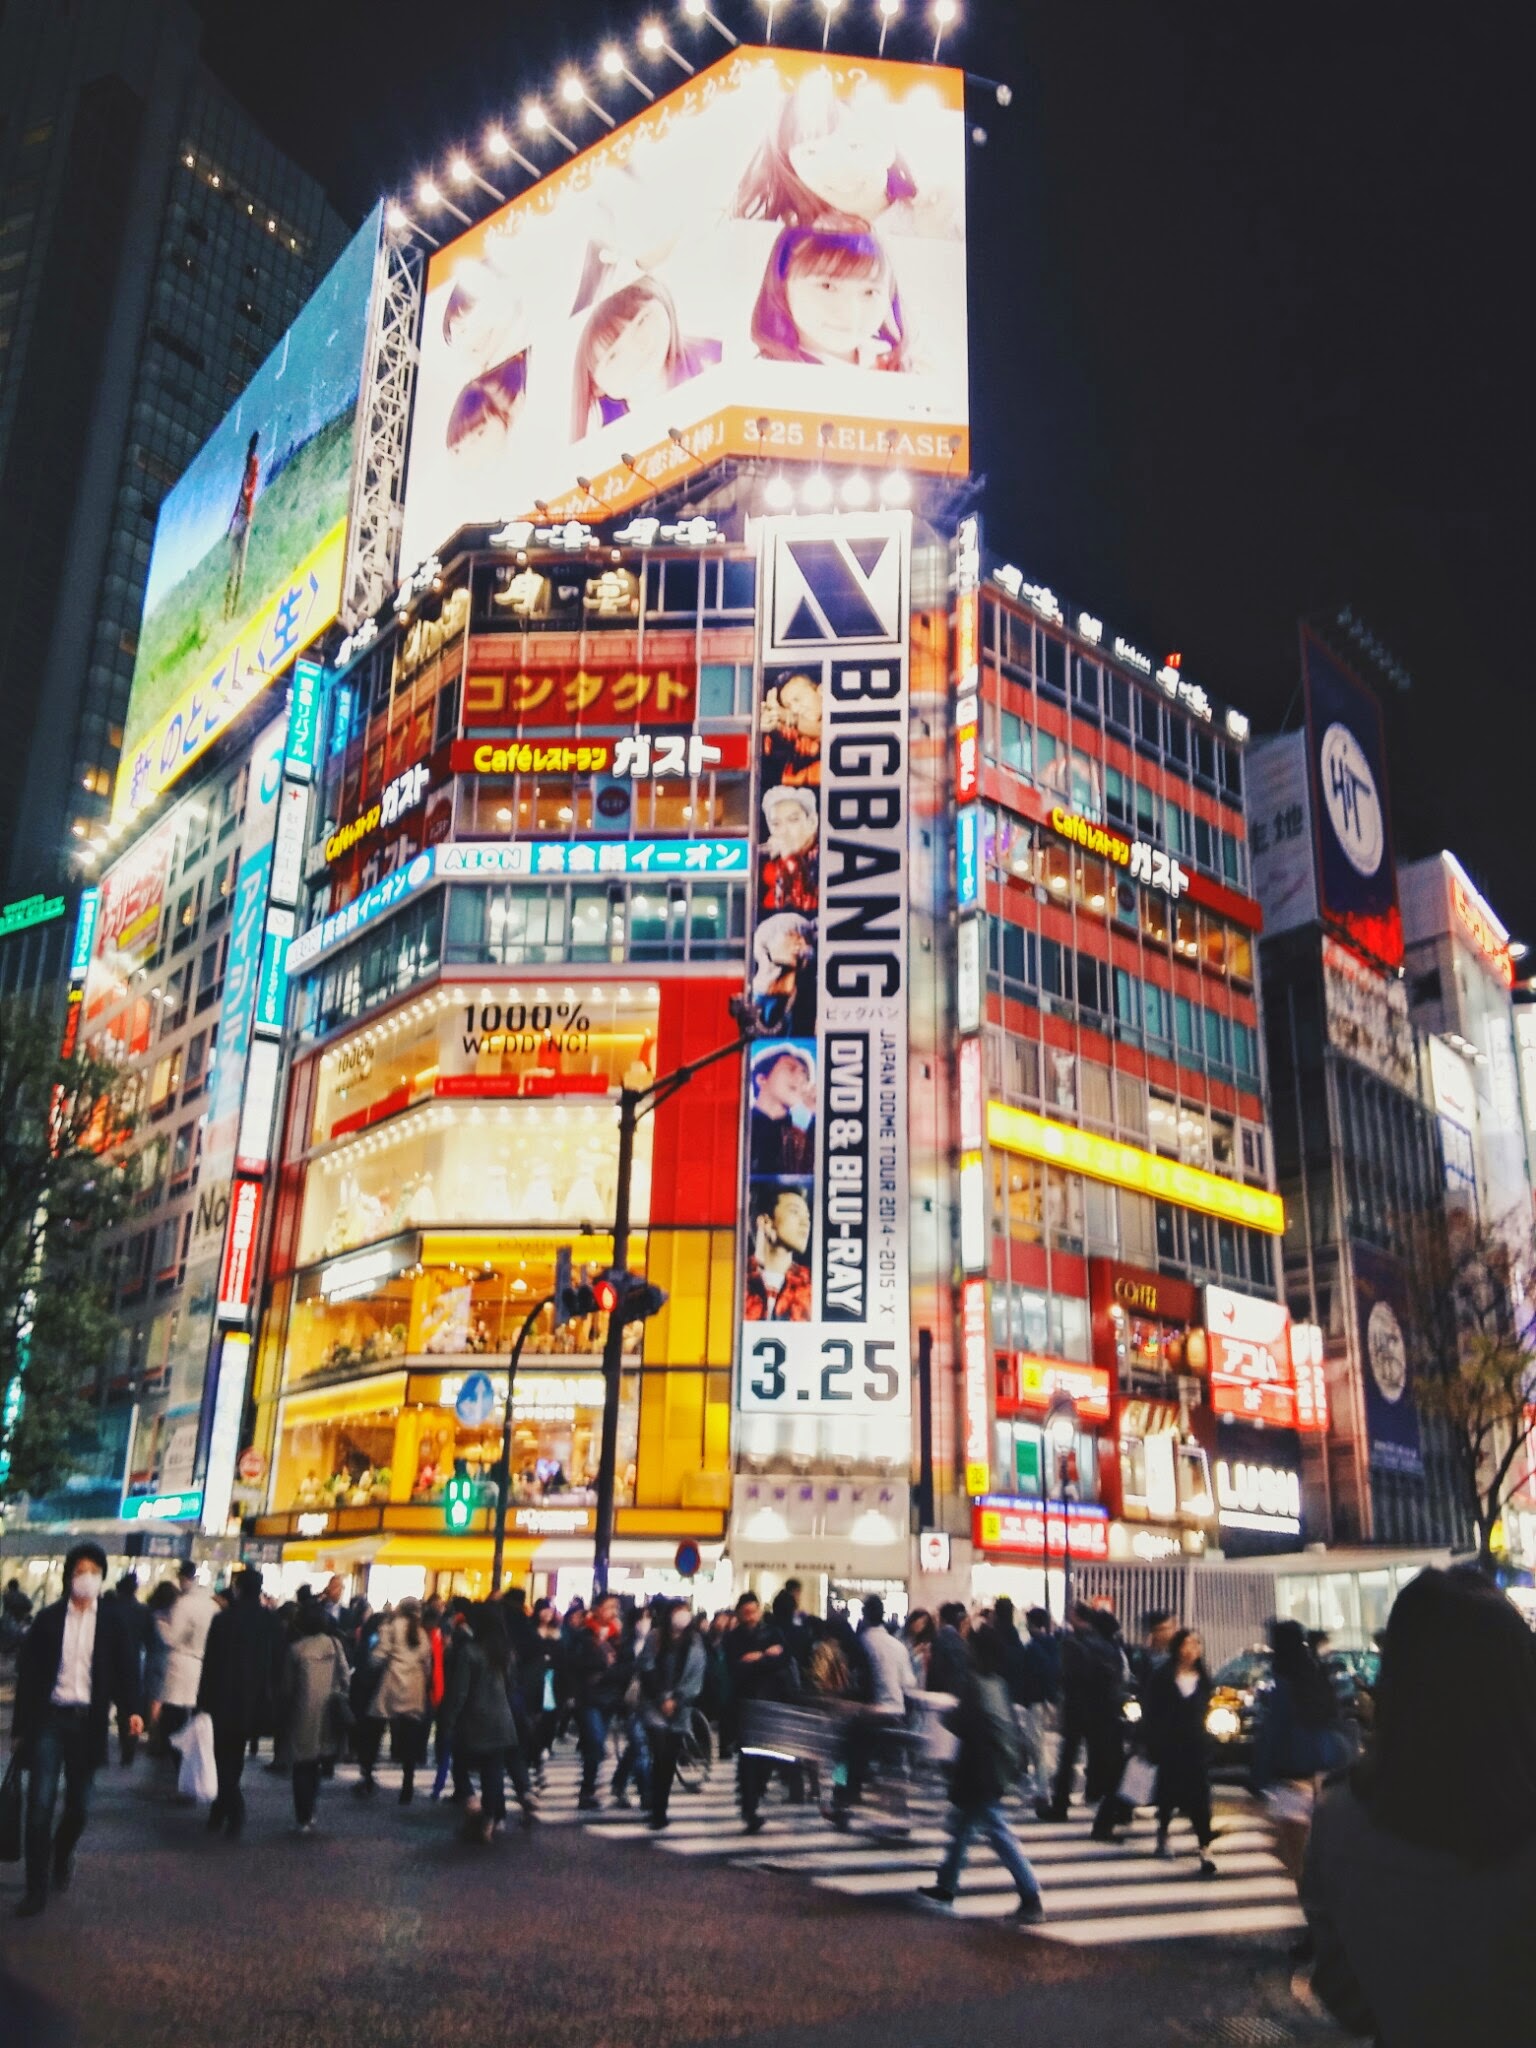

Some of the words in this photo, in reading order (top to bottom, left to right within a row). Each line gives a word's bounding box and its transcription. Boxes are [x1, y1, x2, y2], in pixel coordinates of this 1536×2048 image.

[743, 418, 804, 447] 3.25
[466, 670, 688, 713] コンタクト
[473, 743, 607, 773] Caféレストラン
[613, 734, 722, 778] ガスト
[380, 762, 430, 828] ガスト
[826, 659, 902, 999] BIGBANG
[444, 848, 522, 870] AEON
[1129, 841, 1190, 898] ガスト
[464, 1002, 591, 1033] 1000%
[462, 1034, 590, 1055] WEDDNG!
[880, 1029, 896, 1085] JAPAN
[830, 1039, 863, 1113] DVD
[829, 1118, 863, 1150] &
[880, 1090, 896, 1138] DOME
[879, 1146, 896, 1192] TOUR
[826, 1155, 863, 1316] BLU-RAY
[751, 1337, 900, 1403] 3.25
